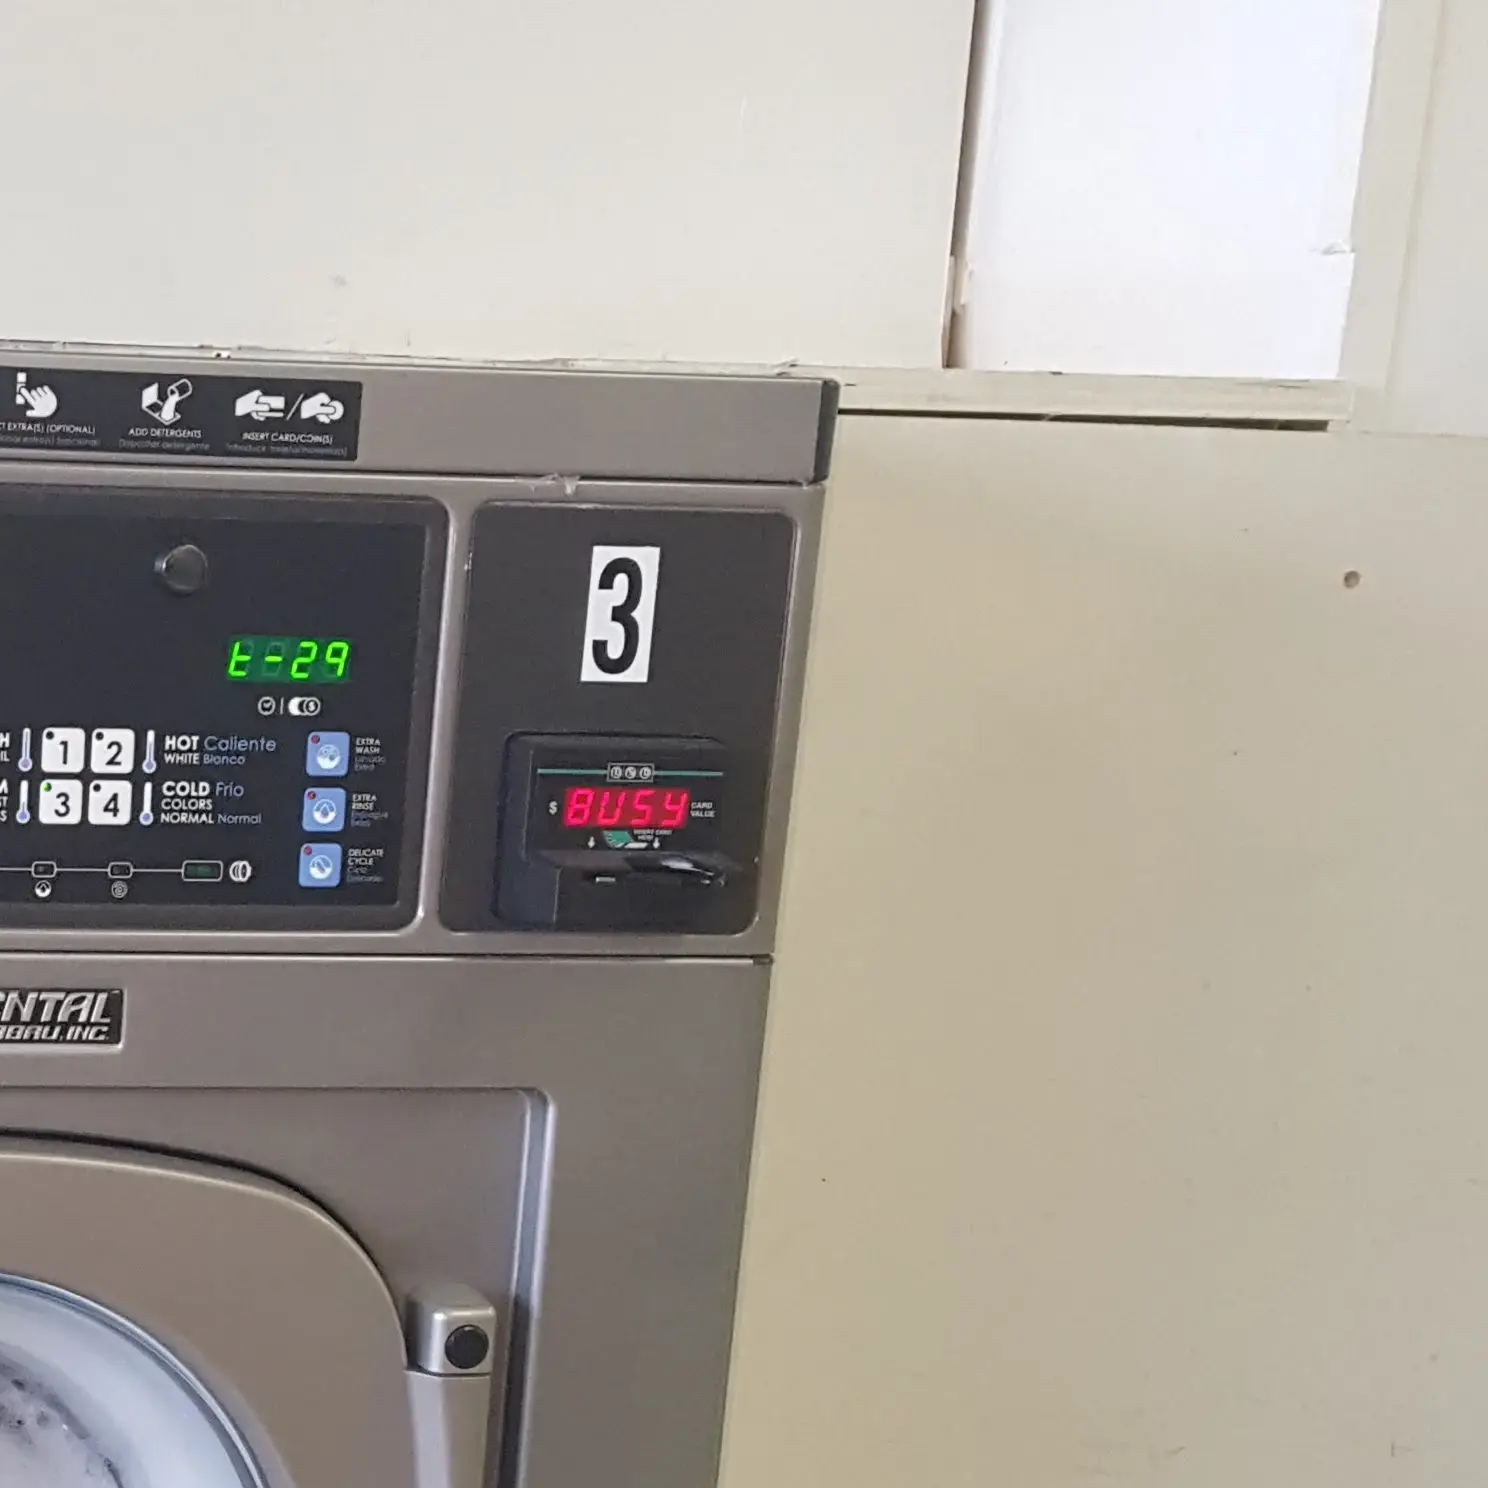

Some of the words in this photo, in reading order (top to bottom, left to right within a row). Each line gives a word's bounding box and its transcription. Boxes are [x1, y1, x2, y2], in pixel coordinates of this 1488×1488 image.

[128, 428, 148, 436] ADD
[150, 428, 201, 438] DETERGENTS
[242, 431, 269, 440] INSERT
[592, 557, 643, 675] 3
[164, 735, 199, 751] HOT
[204, 735, 277, 752] Caliente
[355, 737, 381, 746] EXTRA
[59, 740, 69, 765] 1
[105, 740, 123, 766] 2
[355, 746, 380, 754] WASH
[164, 753, 200, 765] WHITE
[203, 753, 246, 765] Blanco
[162, 781, 210, 797] COLD
[352, 793, 377, 802] EXTRA
[54, 792, 71, 817] 3
[103, 792, 120, 817] 4
[161, 798, 213, 811] COLORS
[351, 802, 375, 811] RINSE
[160, 813, 214, 825] NORMAL
[217, 812, 262, 824] Normal
[348, 848, 384, 857] DELICATE
[348, 857, 374, 866] CYCLE
